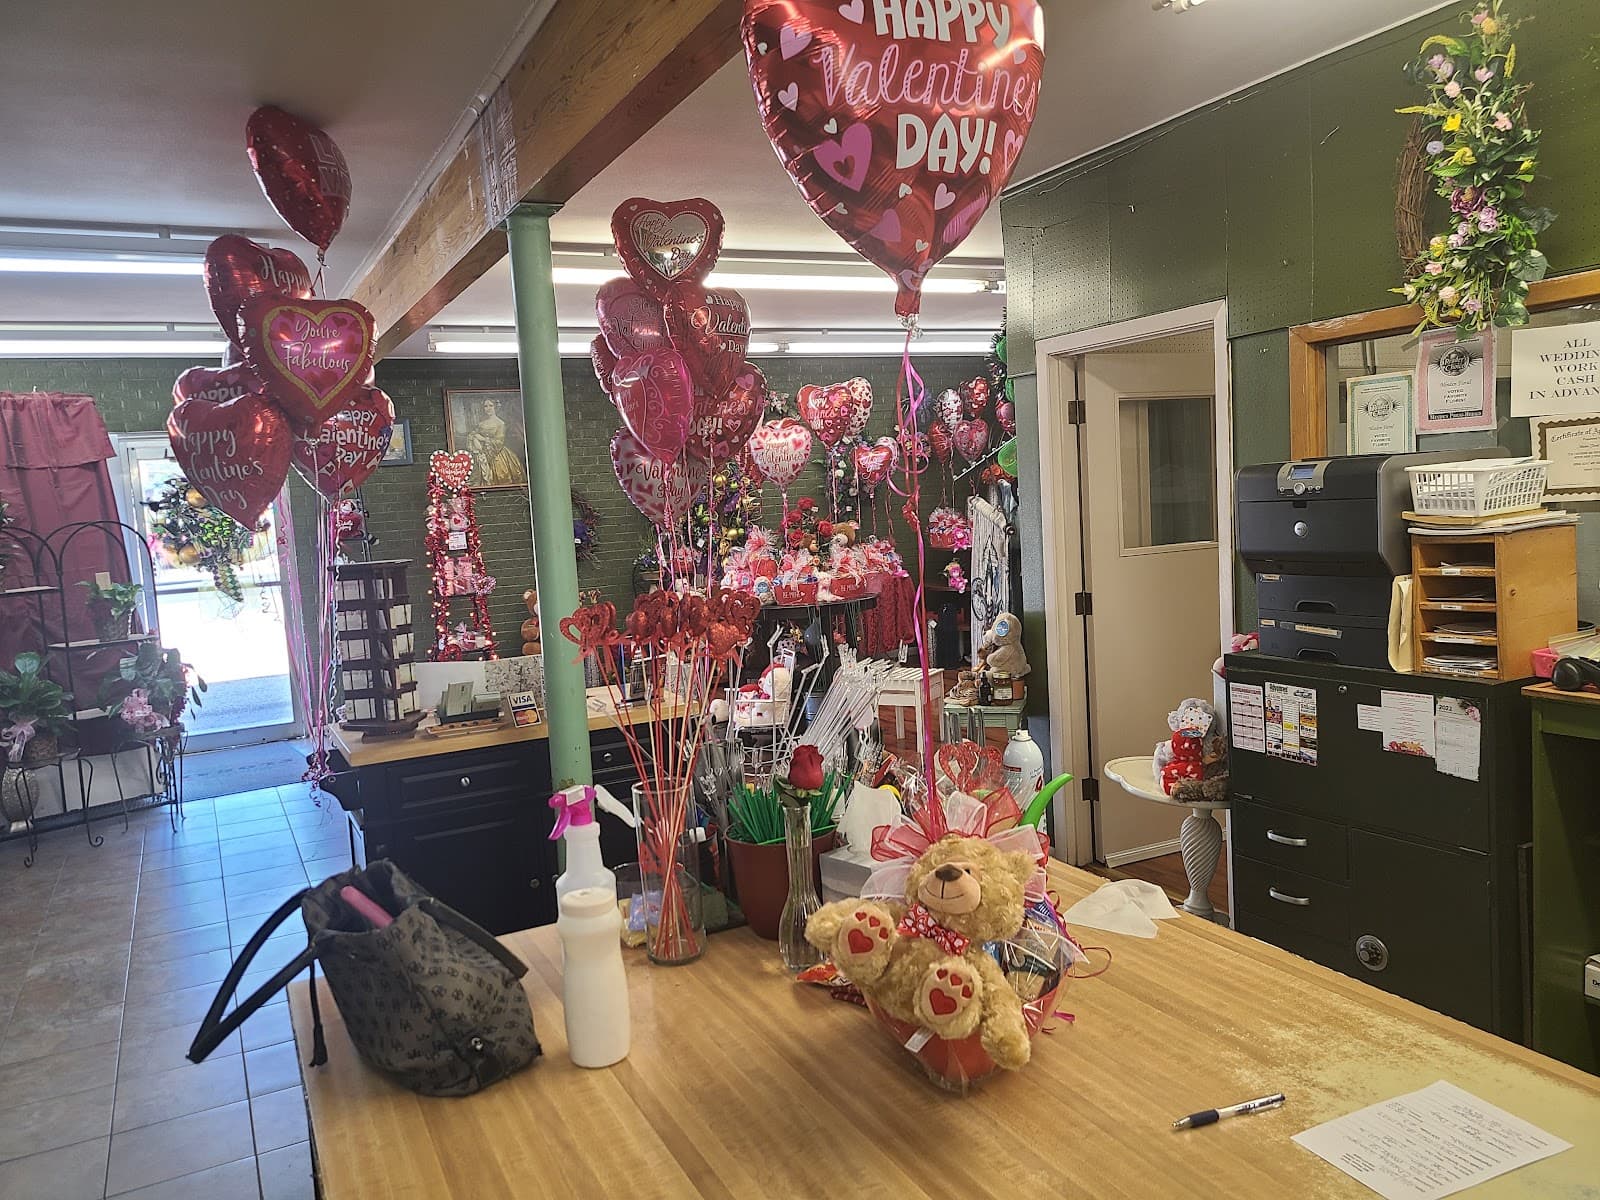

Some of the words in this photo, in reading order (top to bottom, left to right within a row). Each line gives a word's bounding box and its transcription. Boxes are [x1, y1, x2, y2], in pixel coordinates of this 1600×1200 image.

[873, 0, 1010, 48] HAPPY
[896, 113, 998, 175] DAY!
[295, 319, 341, 342] You're
[1564, 338, 1592, 349] ALL
[280, 341, 352, 373] Fabulous
[1553, 362, 1599, 373] WORK
[1556, 374, 1595, 386] CASH
[1529, 390, 1546, 400] IN
[337, 410, 378, 426] appy
[320, 425, 390, 451] alentine's
[185, 452, 264, 484] alentine's
[512, 694, 533, 705] VISA
